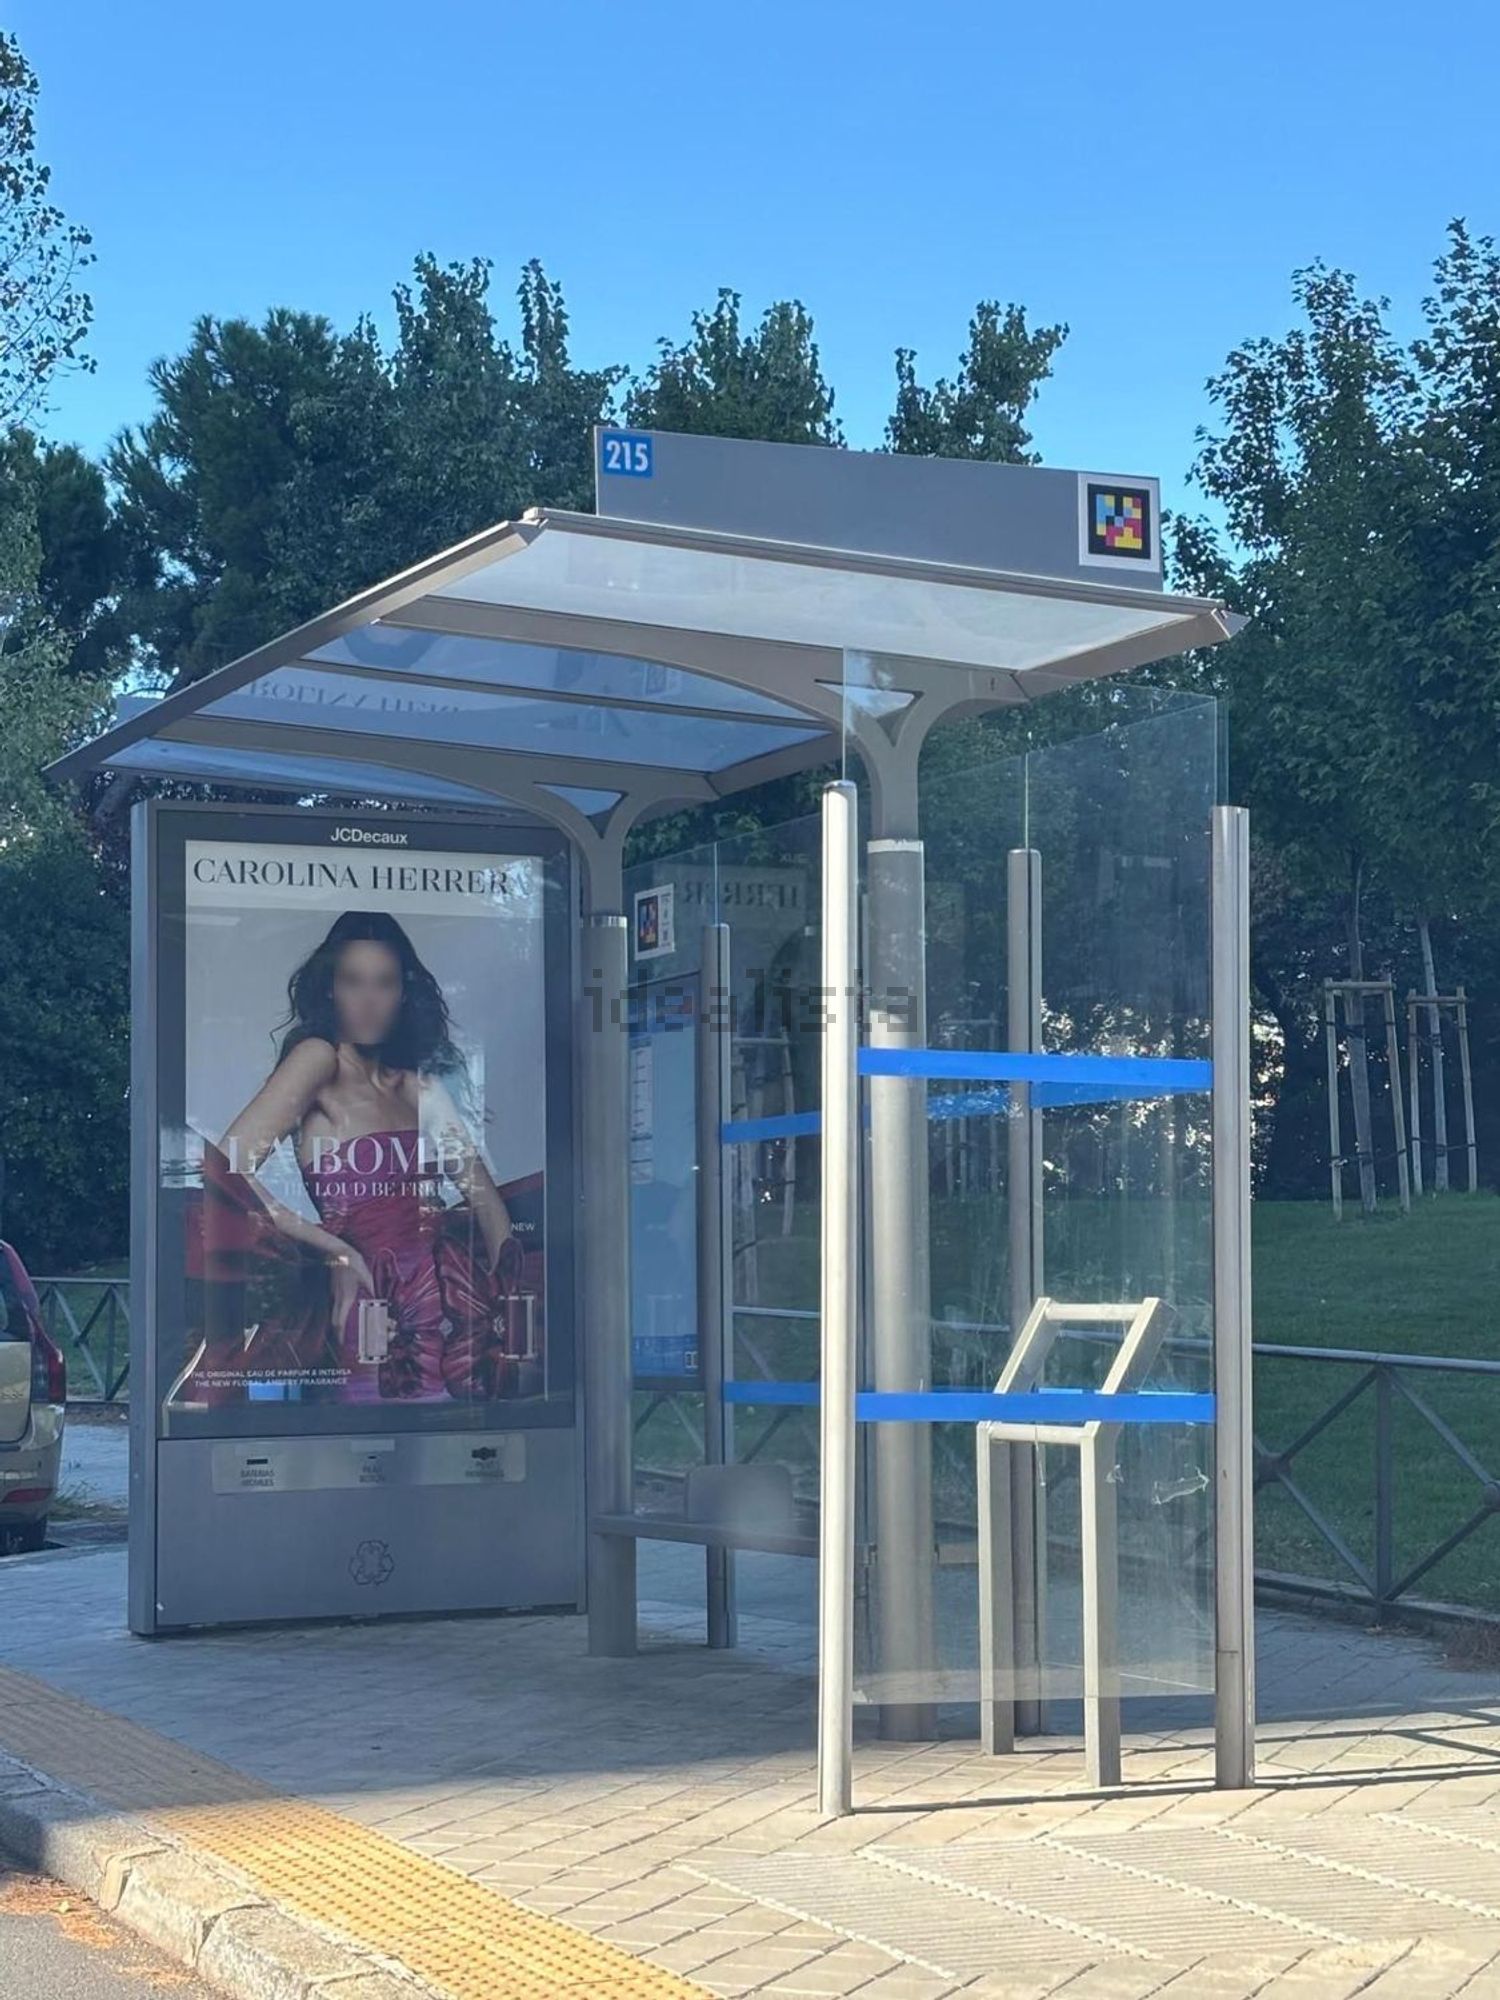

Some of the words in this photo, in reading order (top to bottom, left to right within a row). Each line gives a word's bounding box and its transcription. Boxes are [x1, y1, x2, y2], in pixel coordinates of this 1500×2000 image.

[605, 440, 649, 473] 215
[330, 827, 408, 845] JCDecaux
[193, 857, 360, 890] CAROLINA
[310, 1136, 472, 1175] BOMB
[315, 1181, 366, 1197] LOUD
[371, 1181, 395, 1197] BE
[511, 1222, 536, 1233] NEW
[212, 1379, 230, 1387] NEW
